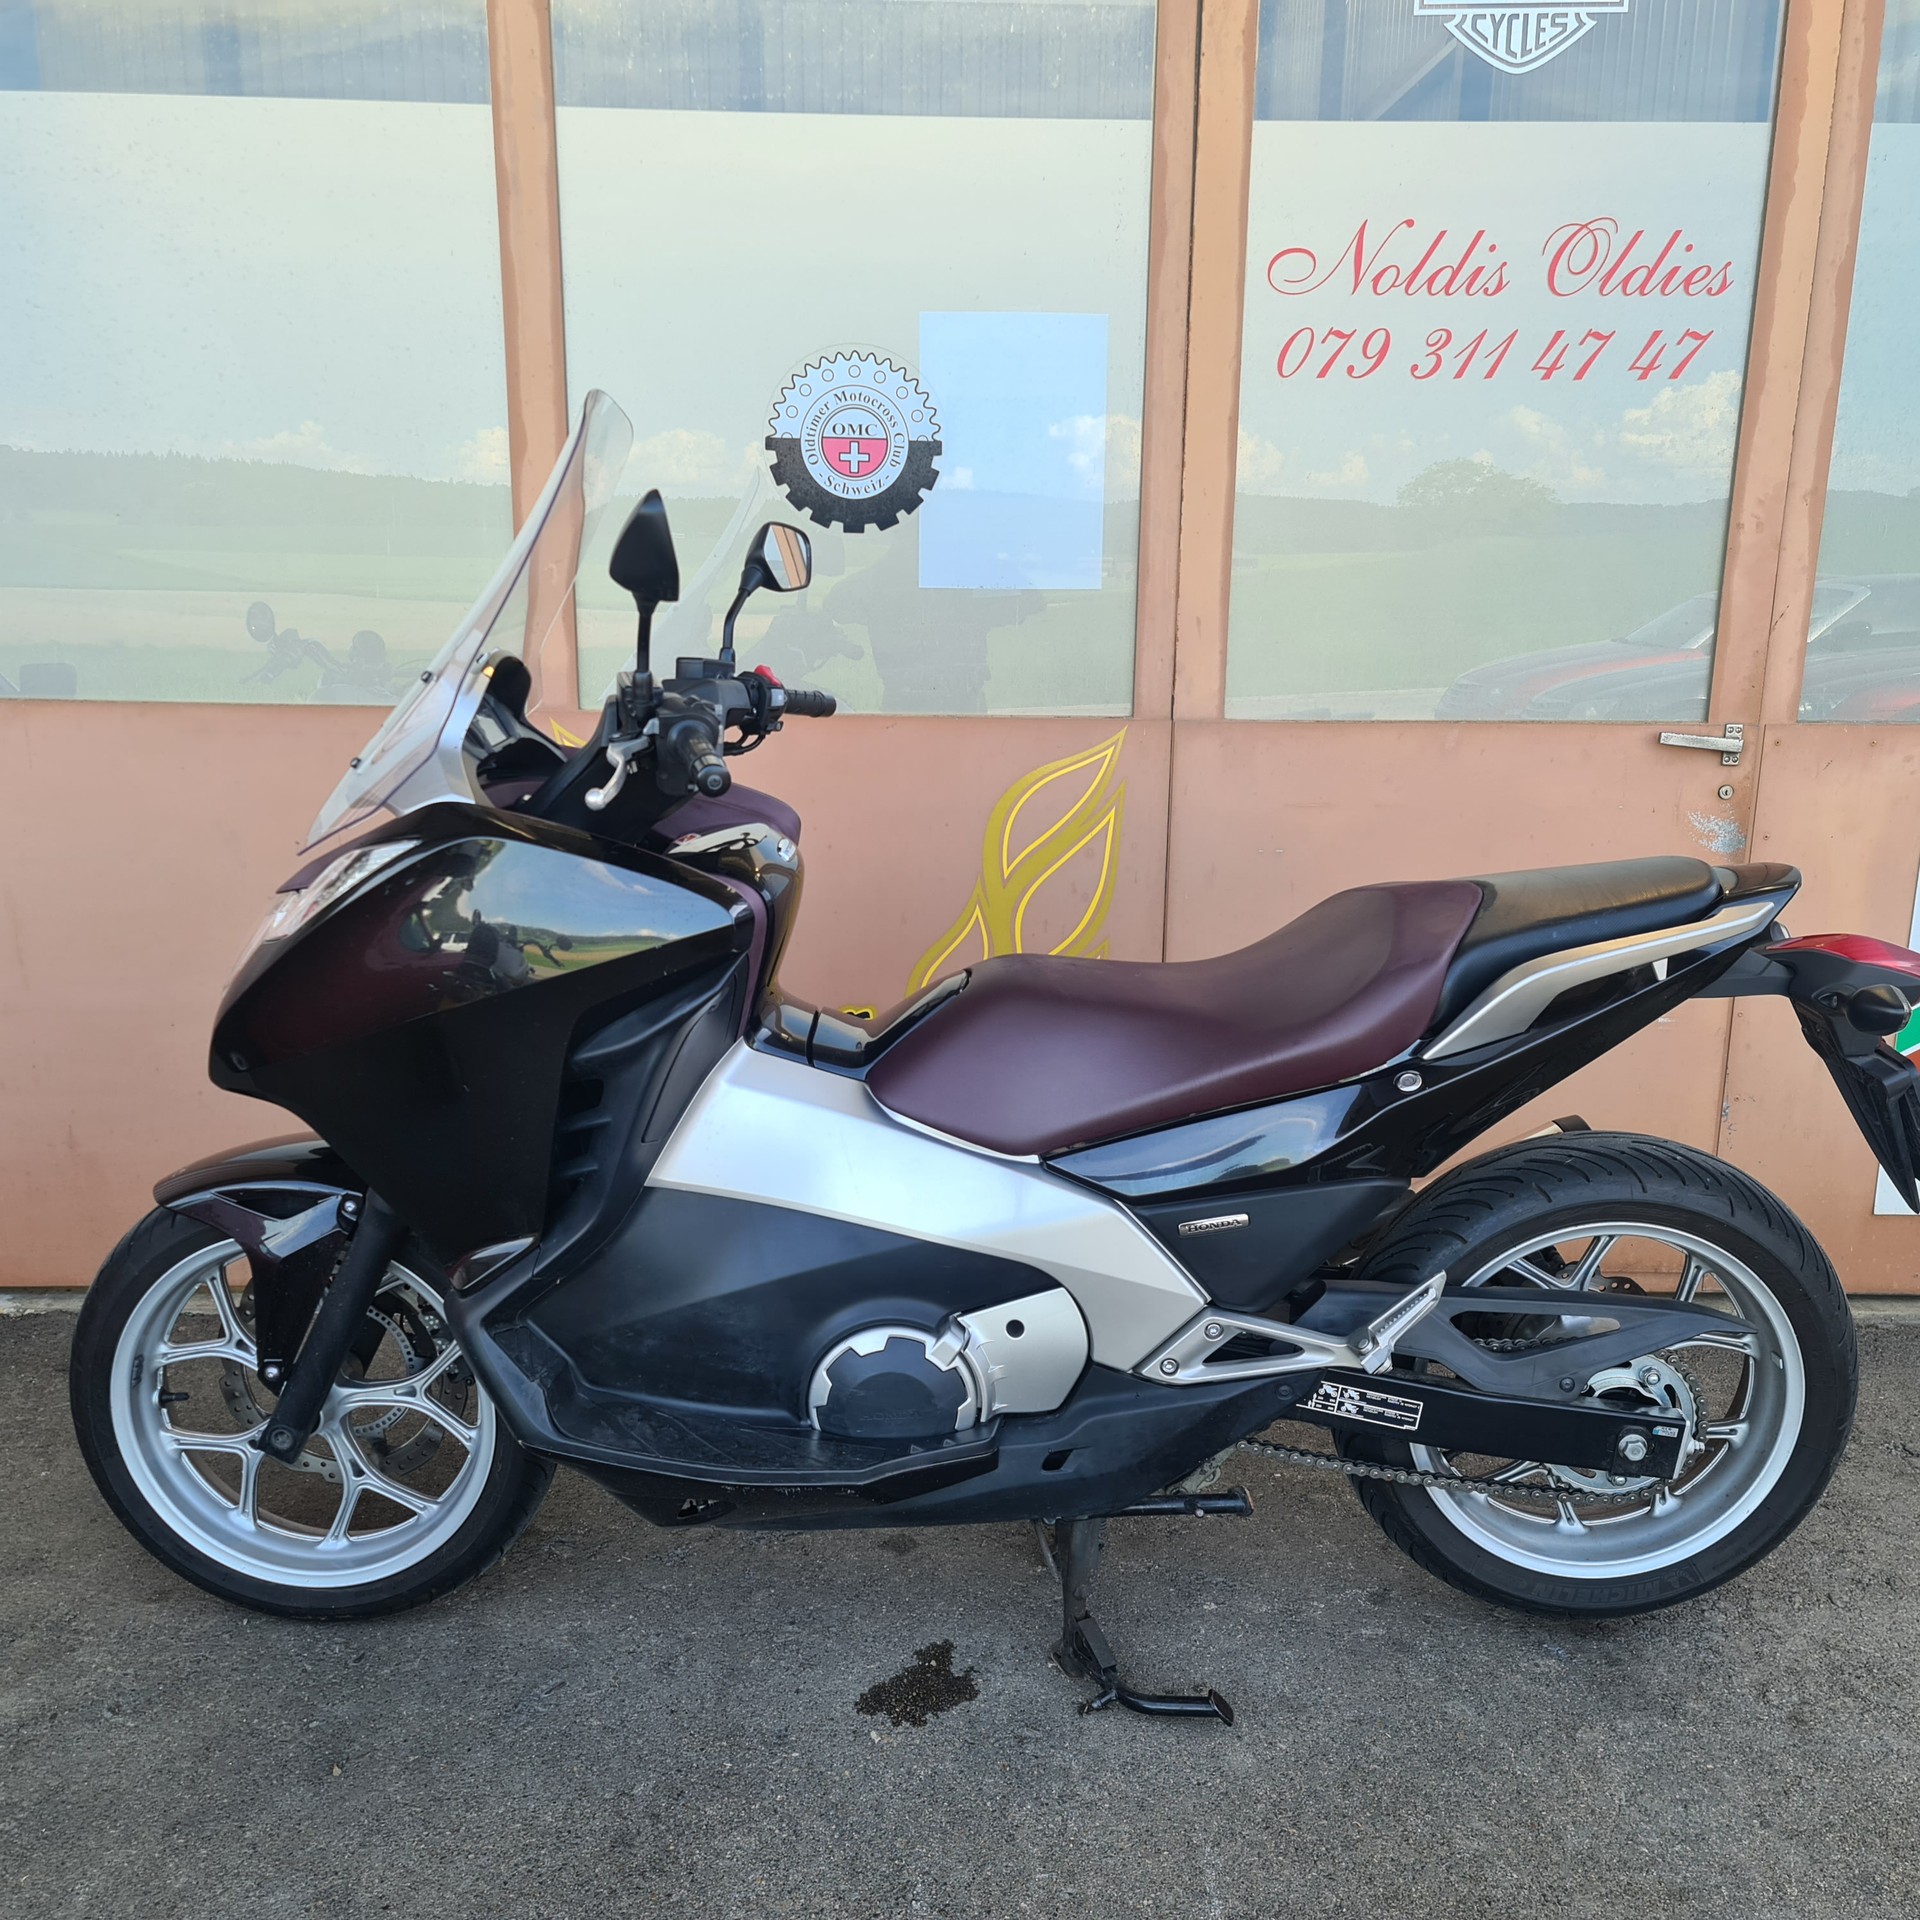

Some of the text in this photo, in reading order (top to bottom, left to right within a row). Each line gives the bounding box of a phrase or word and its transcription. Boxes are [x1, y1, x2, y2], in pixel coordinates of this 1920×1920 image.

[1471, 12, 1569, 60] CYCLES
[1266, 216, 1735, 298] Noldis Oldies
[1276, 326, 1715, 382] 079 311 47 47
[804, 390, 905, 468] Oldtimer Motocross Club
[832, 422, 878, 436] OMC
[824, 475, 885, 495] Schweiz
[1187, 1219, 1242, 1232] HONDA
[1531, 1581, 1659, 1602] MICHELIN
